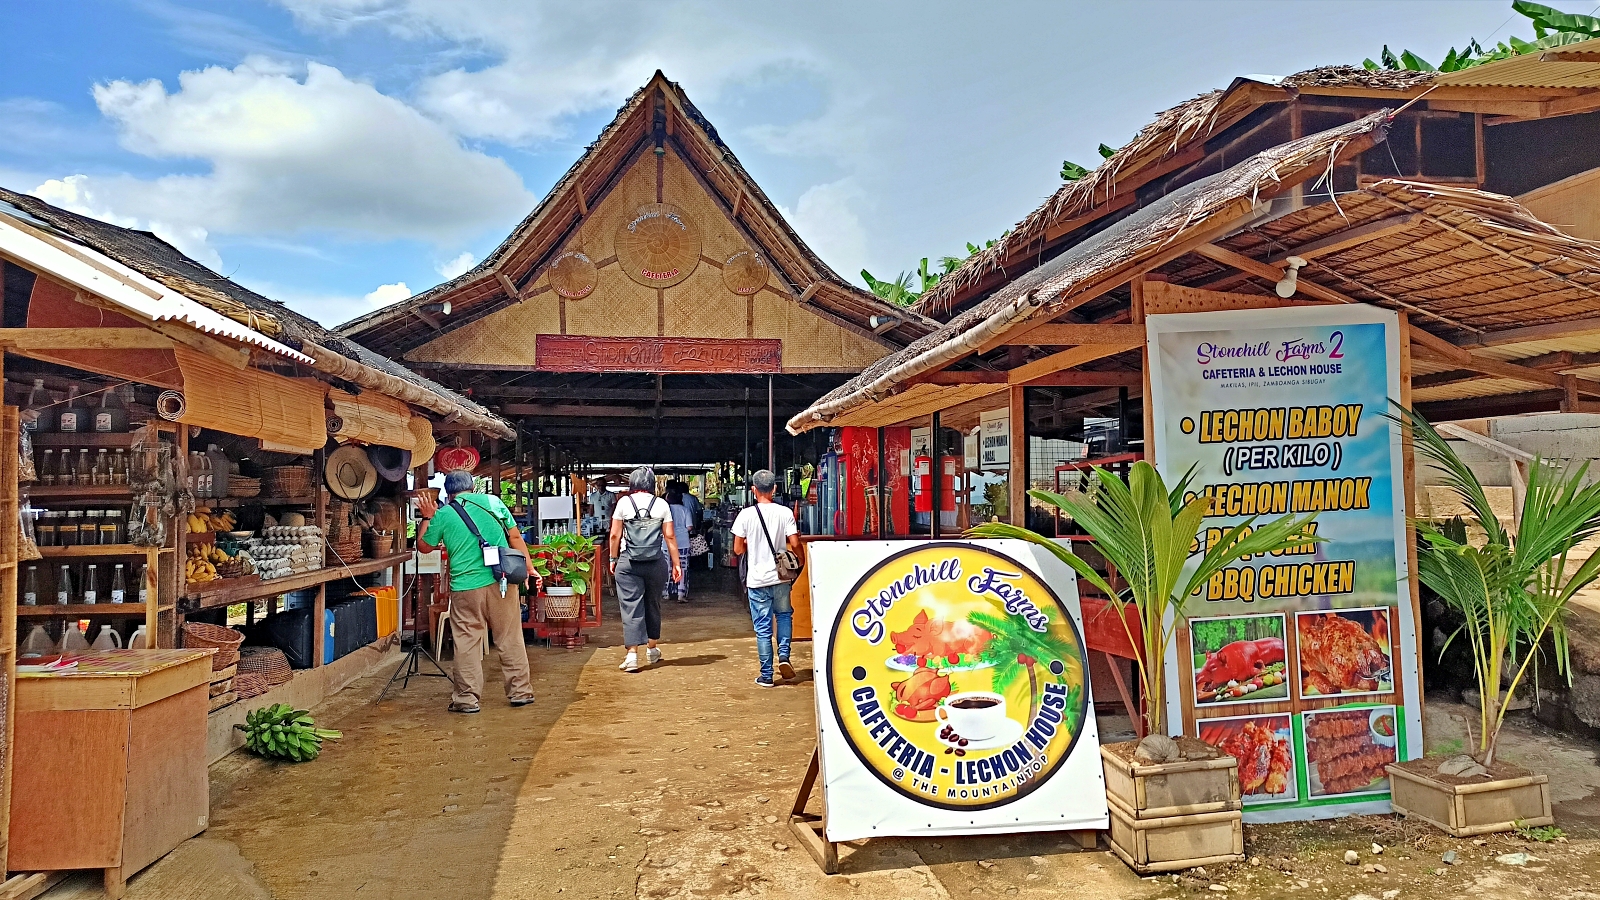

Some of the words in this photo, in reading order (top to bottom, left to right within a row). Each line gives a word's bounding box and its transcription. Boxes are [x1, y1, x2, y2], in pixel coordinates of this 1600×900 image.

[584, 341, 664, 366] Stonehill
[673, 343, 738, 366] Farms
[1197, 341, 1271, 365] Stonehill
[1276, 338, 1327, 362] Farms
[1329, 330, 1345, 359] 2
[1203, 367, 1255, 380] CAFETERIA
[1259, 367, 1265, 377] &
[1268, 365, 1307, 377] LECHON
[1310, 363, 1342, 375] HOUSE
[1263, 379, 1300, 387] ZAMBOANGA
[1199, 410, 1285, 443] LECHON
[1287, 404, 1363, 439] BABOY
[1203, 482, 1289, 517] LECHON
[1291, 476, 1372, 513] MANOK
[852, 558, 961, 644] Stonehill
[969, 568, 1046, 631] Farms
[1207, 567, 1255, 602] BBQ
[1258, 560, 1355, 598] CHICKEN
[852, 686, 935, 779] CAFETERIA
[955, 741, 1033, 785] LECHON
[1026, 683, 1068, 751] HOUSE
[892, 768, 905, 780] @
[912, 778, 938, 795] THE
[947, 755, 1049, 799] MOUNTAINTOP
